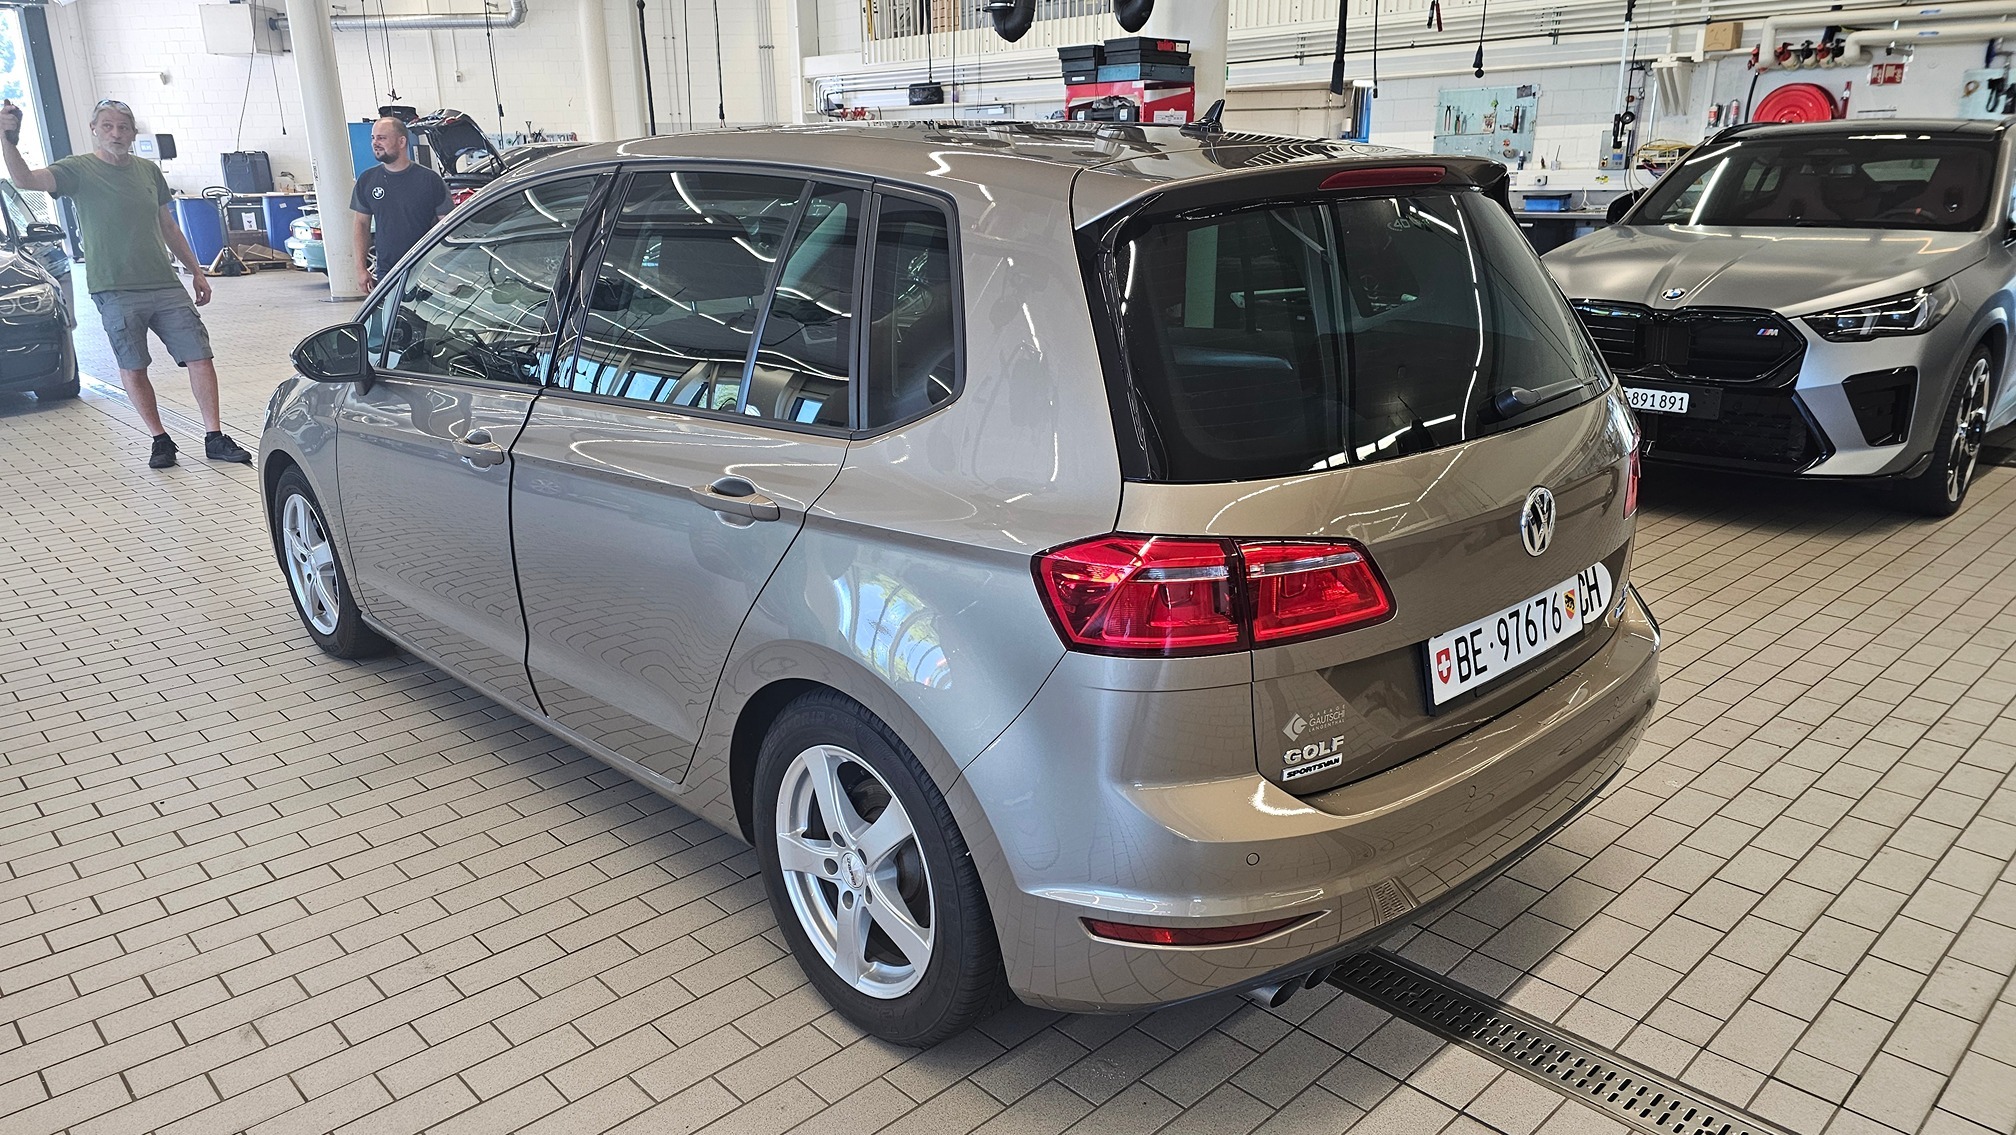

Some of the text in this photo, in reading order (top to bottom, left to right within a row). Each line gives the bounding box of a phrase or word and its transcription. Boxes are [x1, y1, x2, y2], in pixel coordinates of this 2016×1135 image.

[1308, 709, 1346, 727] GAUTSCHI
[1284, 735, 1345, 765] GOLF
[1286, 757, 1340, 778] SPORTSVAN
